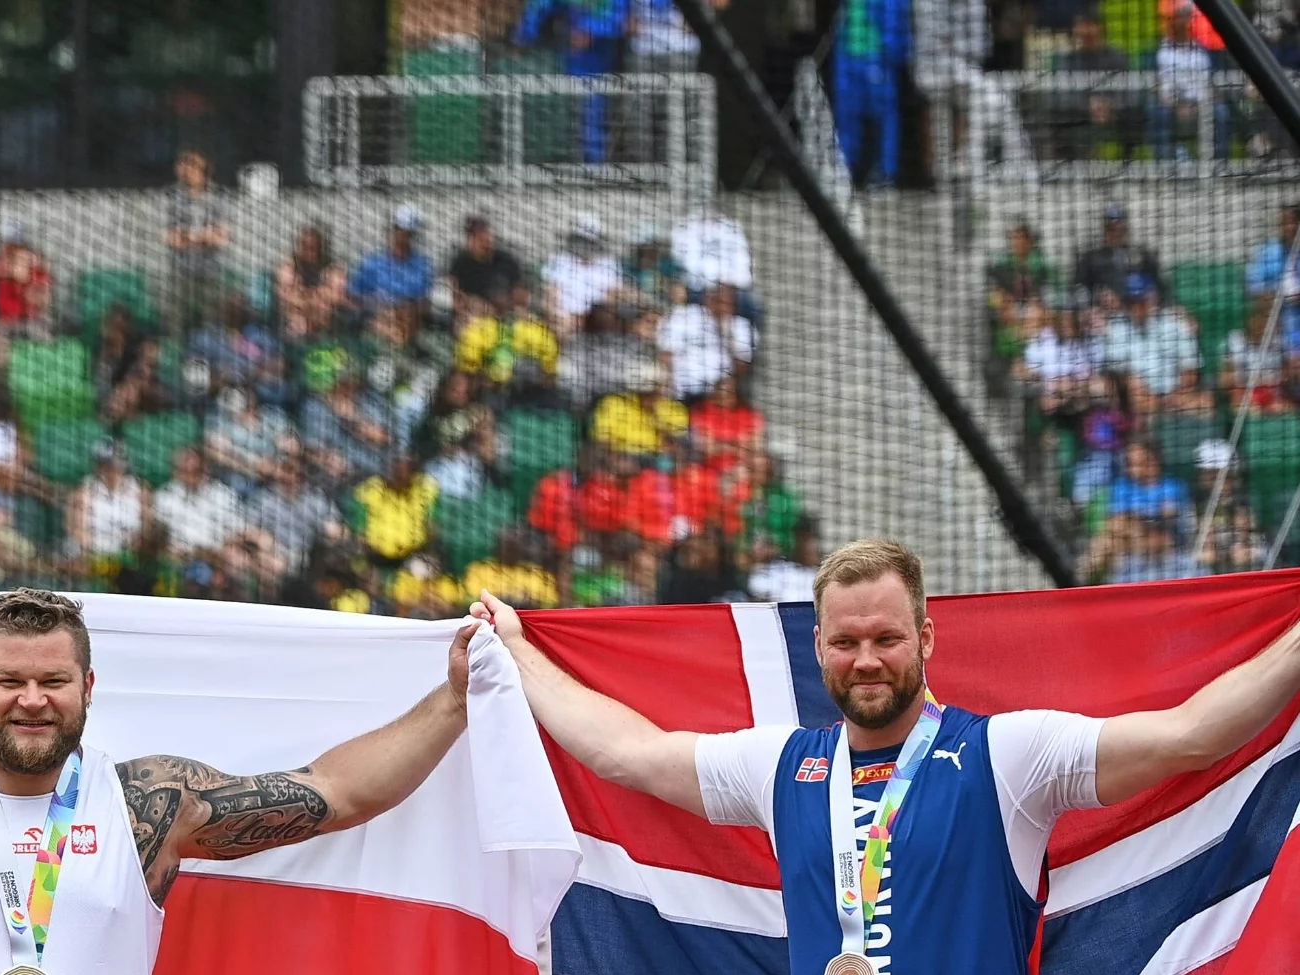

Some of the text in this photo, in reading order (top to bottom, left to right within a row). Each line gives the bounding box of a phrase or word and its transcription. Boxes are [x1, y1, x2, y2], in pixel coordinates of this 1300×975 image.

[866, 767, 893, 778] EXTR
[847, 860, 855, 888] OREGON
[10, 880, 21, 908] OREGON
